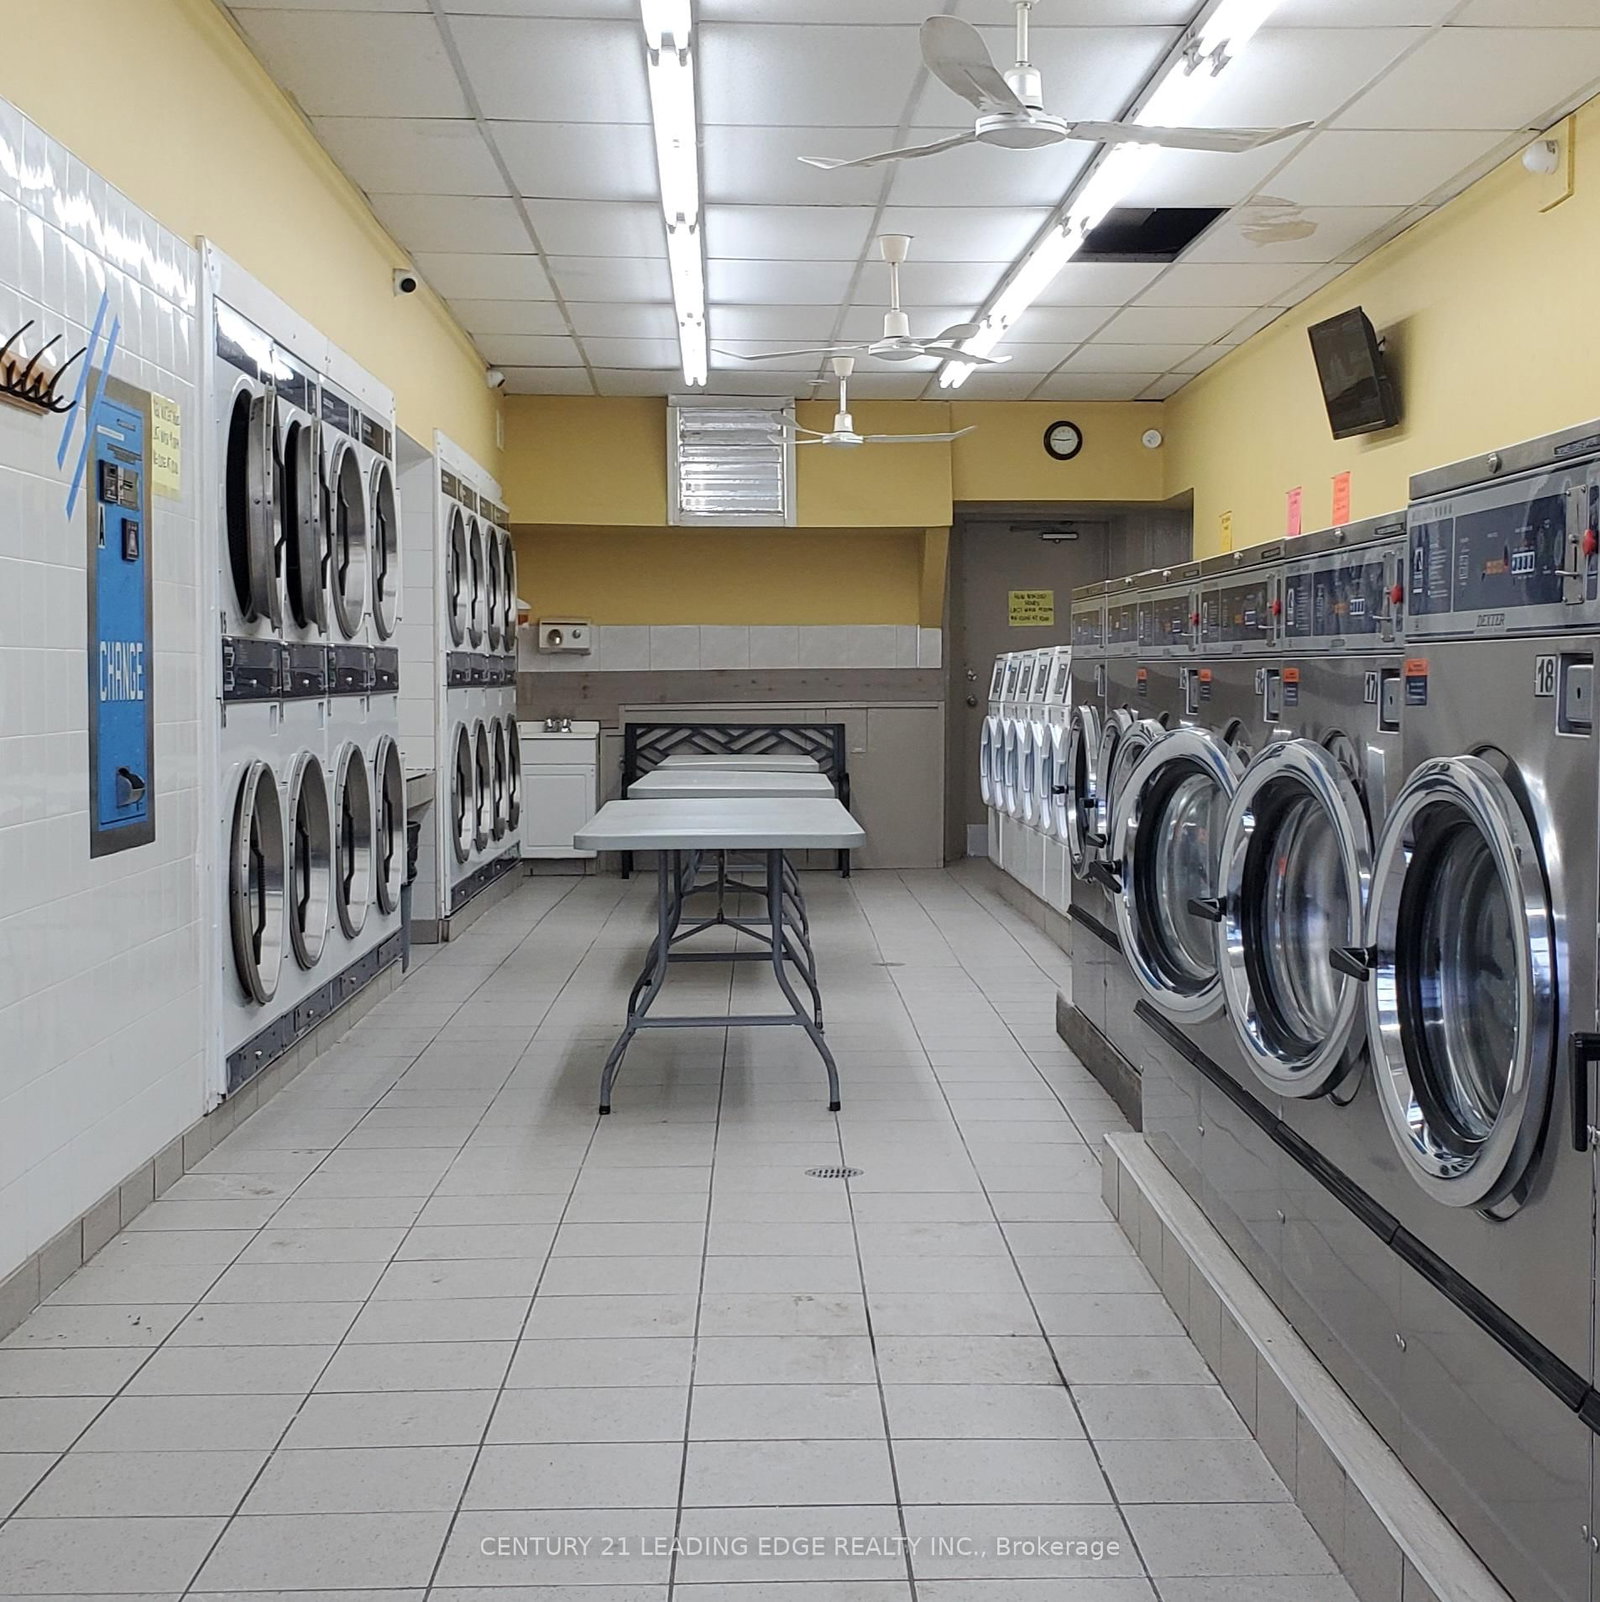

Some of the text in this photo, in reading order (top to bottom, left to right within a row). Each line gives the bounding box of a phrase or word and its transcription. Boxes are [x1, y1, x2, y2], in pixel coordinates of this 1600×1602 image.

[1476, 613, 1505, 628] DEXTER
[99, 641, 144, 701] CHANGE
[1538, 659, 1554, 693] 18
[1366, 673, 1376, 701] 17
